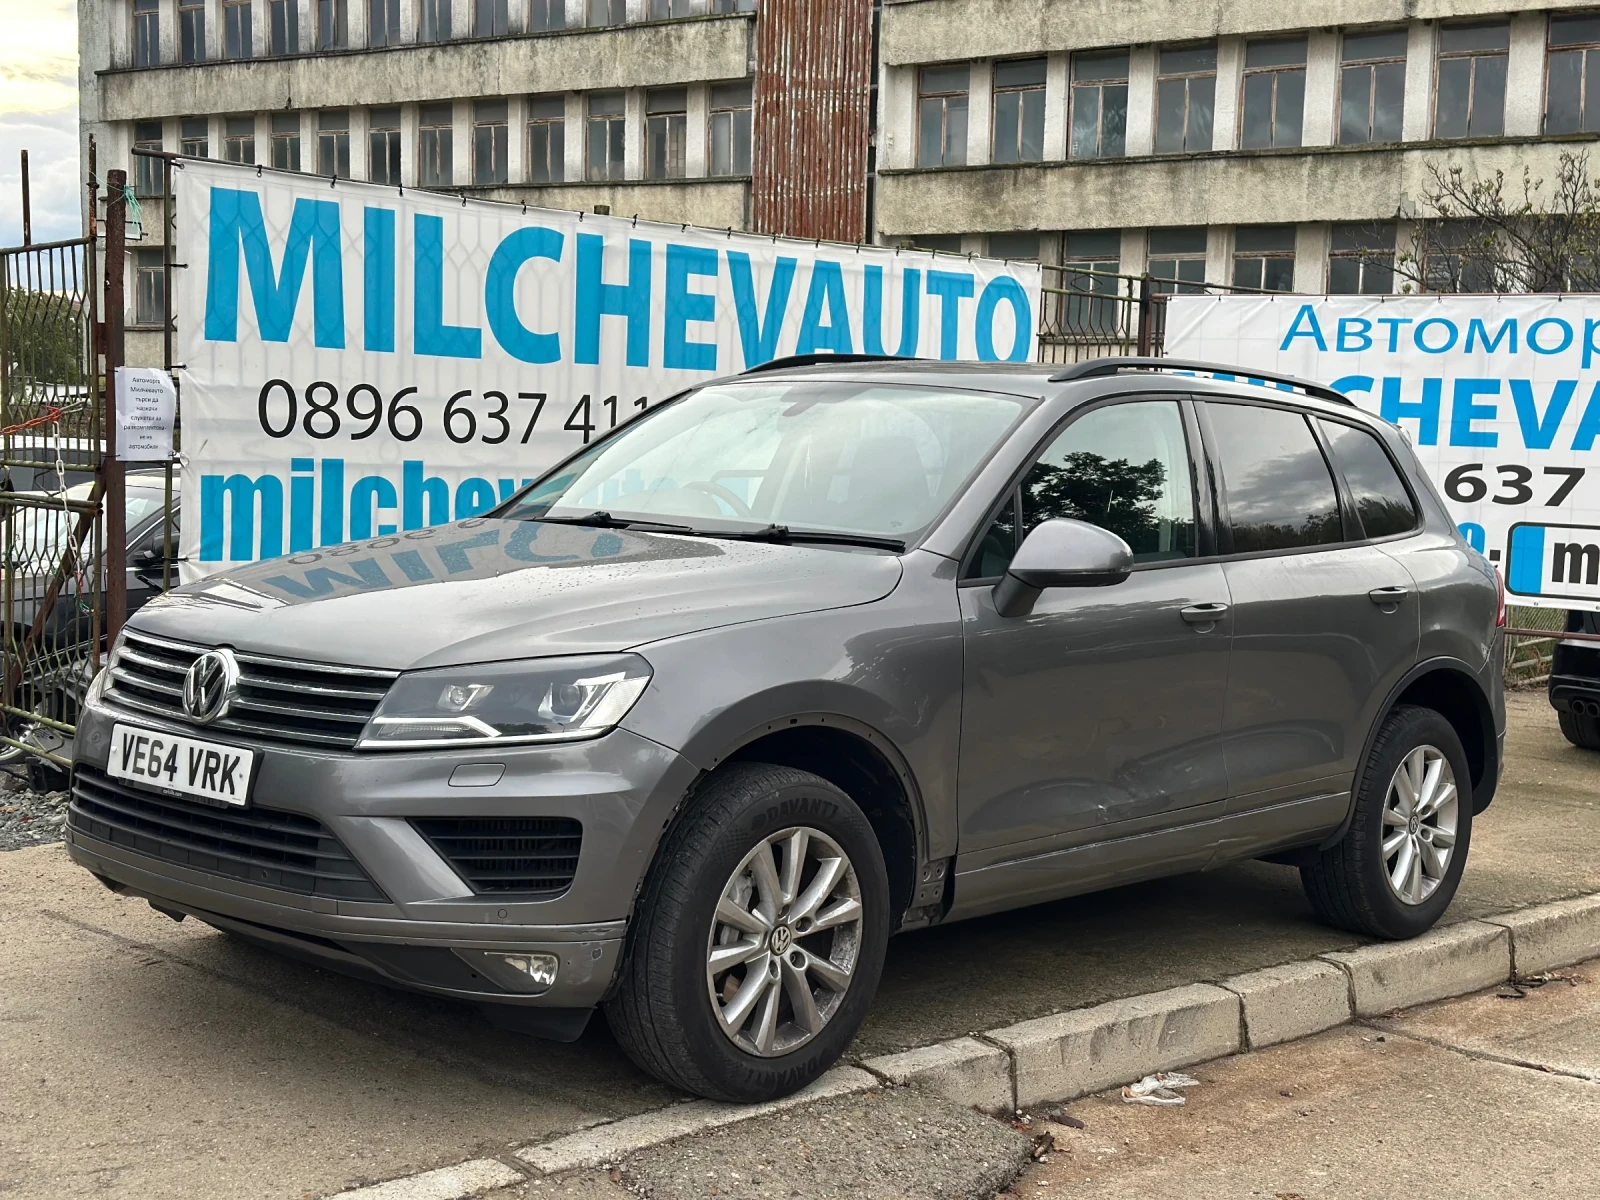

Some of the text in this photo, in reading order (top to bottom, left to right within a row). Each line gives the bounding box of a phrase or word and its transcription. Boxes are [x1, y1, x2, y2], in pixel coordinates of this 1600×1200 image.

[205, 187, 1032, 371] MILCHEVAUTO
[258, 379, 648, 445] 0896 637 41
[1444, 463, 1586, 507] 637
[121, 732, 241, 796] VE64 VRK
